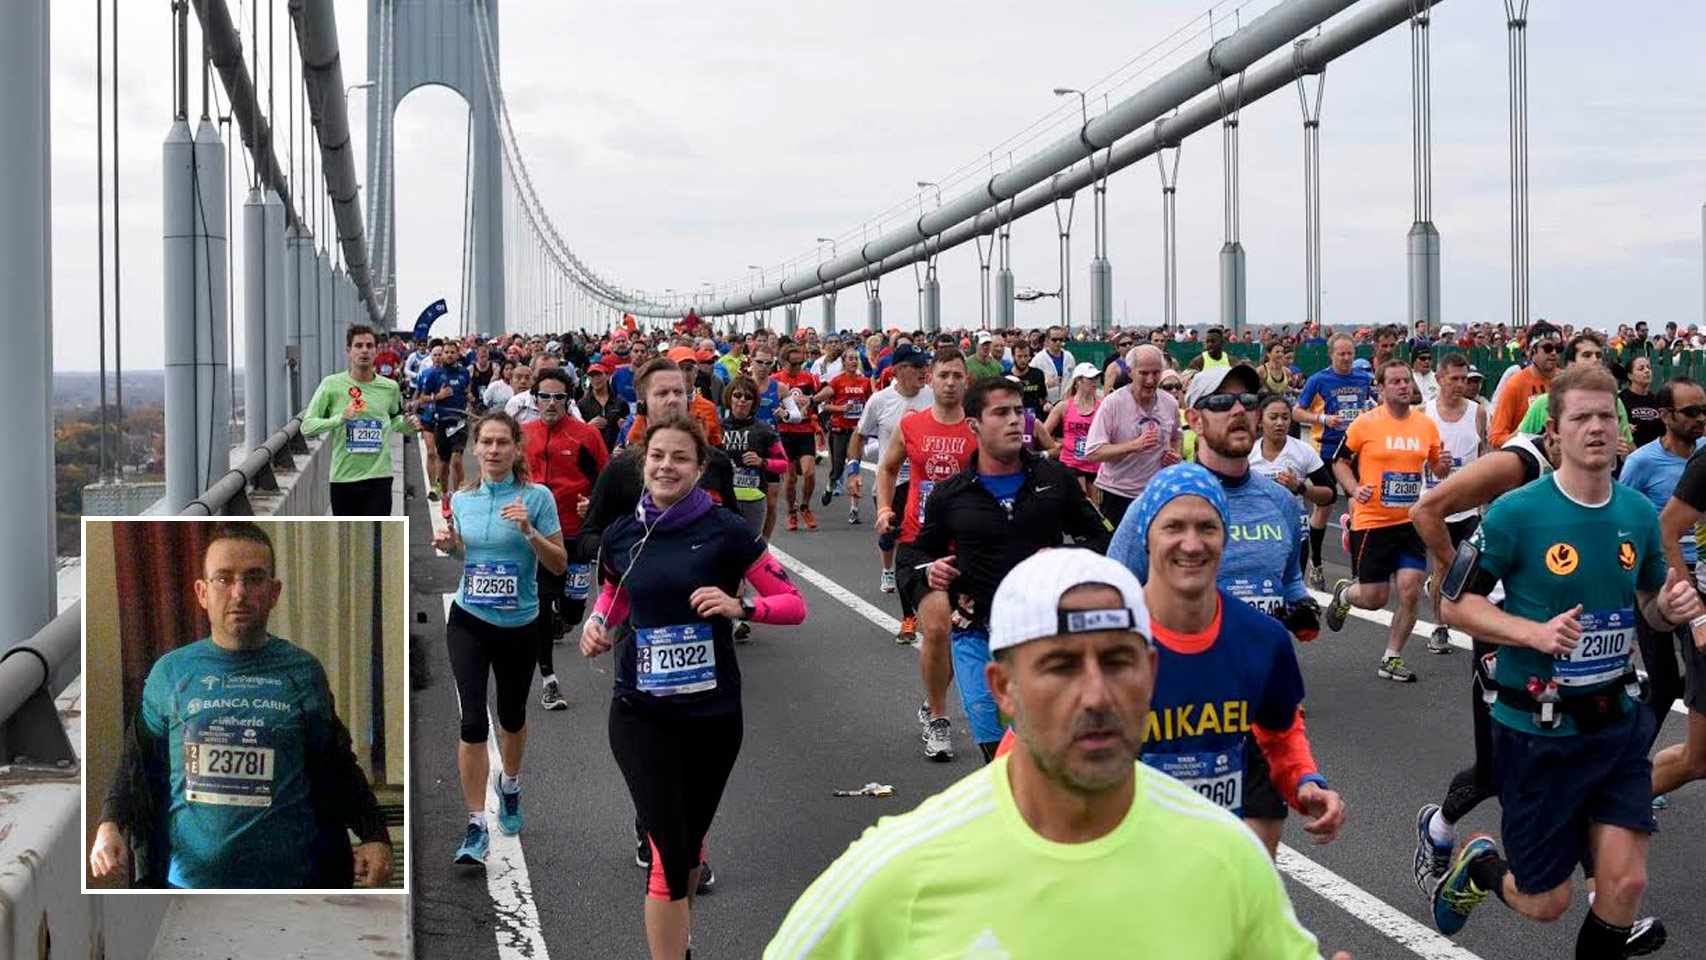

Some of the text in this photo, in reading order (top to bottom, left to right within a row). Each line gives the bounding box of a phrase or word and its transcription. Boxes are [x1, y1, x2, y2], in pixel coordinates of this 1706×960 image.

[358, 430, 381, 440] 23122
[722, 430, 750, 444] NM
[922, 435, 967, 454] FDNY
[1386, 436, 1420, 451] IAN
[475, 578, 514, 594] 22526
[1582, 633, 1625, 657] 23110
[658, 645, 708, 669] 21322
[203, 698, 291, 712] BANCA CARIM
[208, 749, 266, 776] 23781
